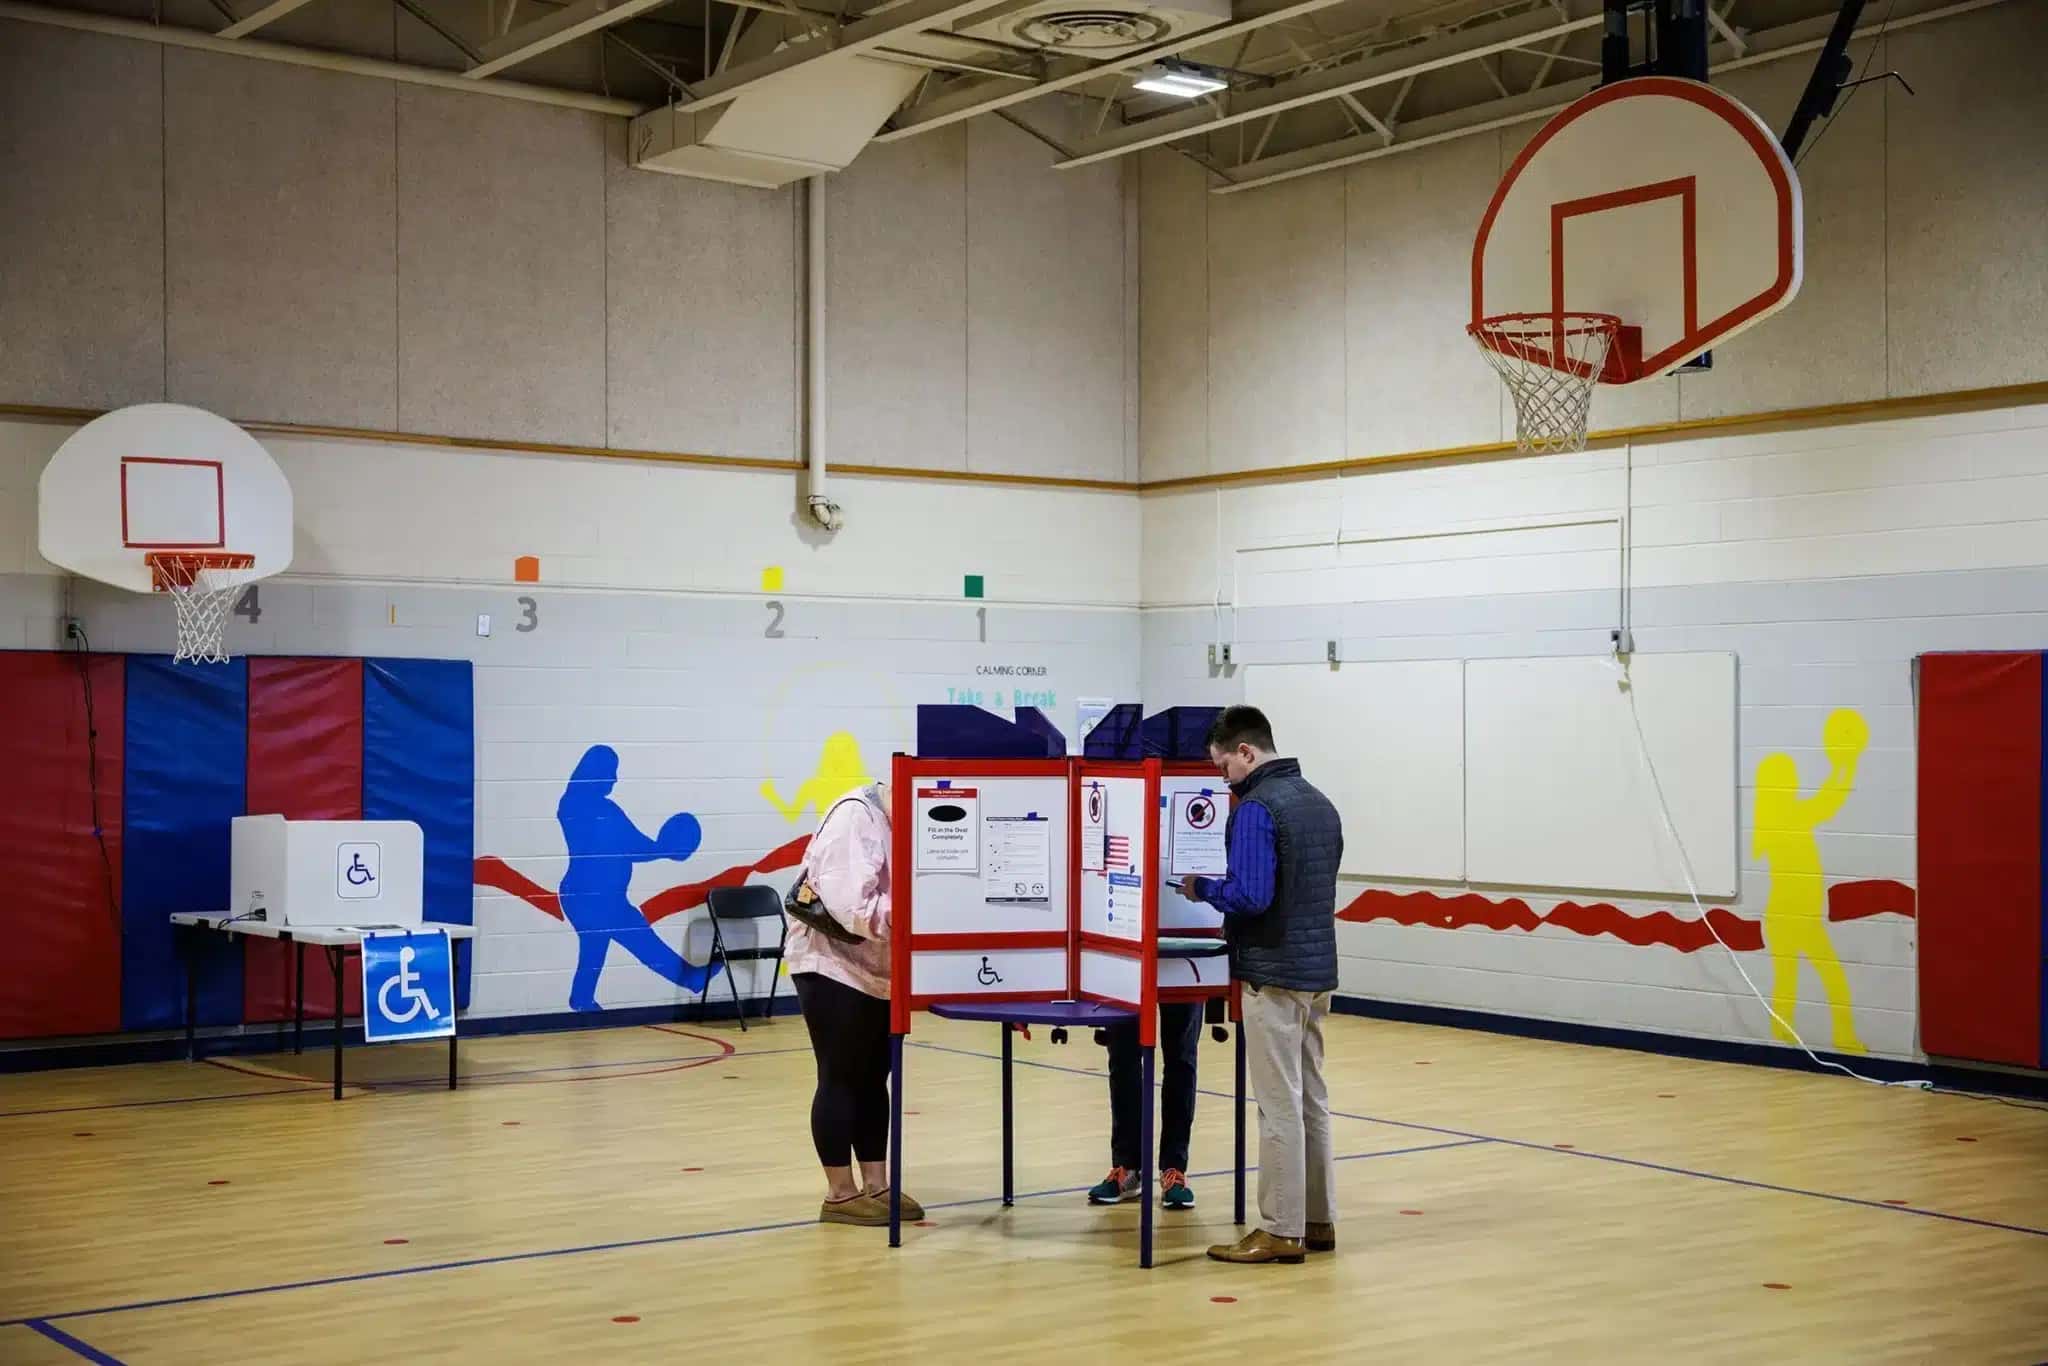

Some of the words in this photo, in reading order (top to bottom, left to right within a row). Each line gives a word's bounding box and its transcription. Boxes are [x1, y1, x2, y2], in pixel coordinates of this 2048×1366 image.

[234, 585, 262, 624] 4
[515, 596, 538, 633] 3
[764, 600, 785, 638] 2
[976, 607, 986, 643] 1
[976, 665, 1014, 676] CALMING
[1016, 666, 1047, 676] CORNER
[947, 688, 984, 705] Take
[994, 692, 1004, 706] a
[1014, 688, 1056, 706] Break
